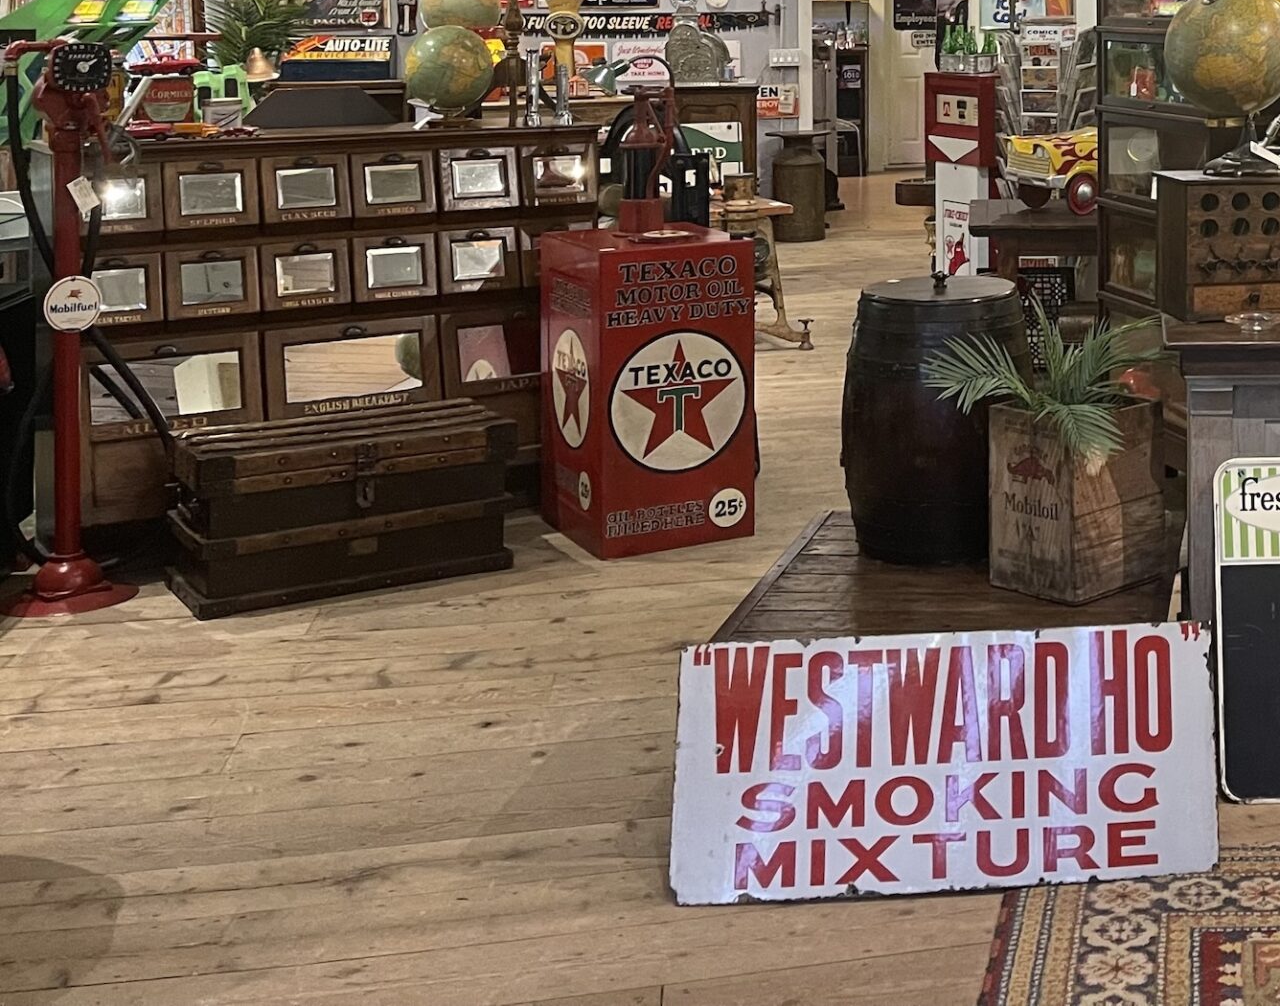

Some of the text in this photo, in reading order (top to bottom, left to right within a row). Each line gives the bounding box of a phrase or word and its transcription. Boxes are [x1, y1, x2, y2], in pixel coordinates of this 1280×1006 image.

[607, 16, 650, 30] SLEEVE
[302, 51, 389, 59] SERVICE PARTS
[324, 39, 390, 52] AUTO-LITE
[619, 254, 738, 285] TEXACO
[616, 282, 701, 307] MOTOR
[706, 278, 744, 298] OIL
[49, 302, 98, 314] Mobilfuel
[606, 298, 751, 328] HEAVY DUTY
[628, 358, 732, 387] TEXACO
[304, 393, 409, 414] ENGLISH BREAKFAST
[658, 385, 700, 432] T
[606, 500, 704, 525] OIL BOTTLES
[714, 498, 744, 518] 25¢
[1003, 490, 1059, 521] Mobiloil
[606, 512, 705, 538] FILLED HERE
[735, 762, 1160, 833] SMOKING
[734, 819, 1160, 891] MIXTURE
